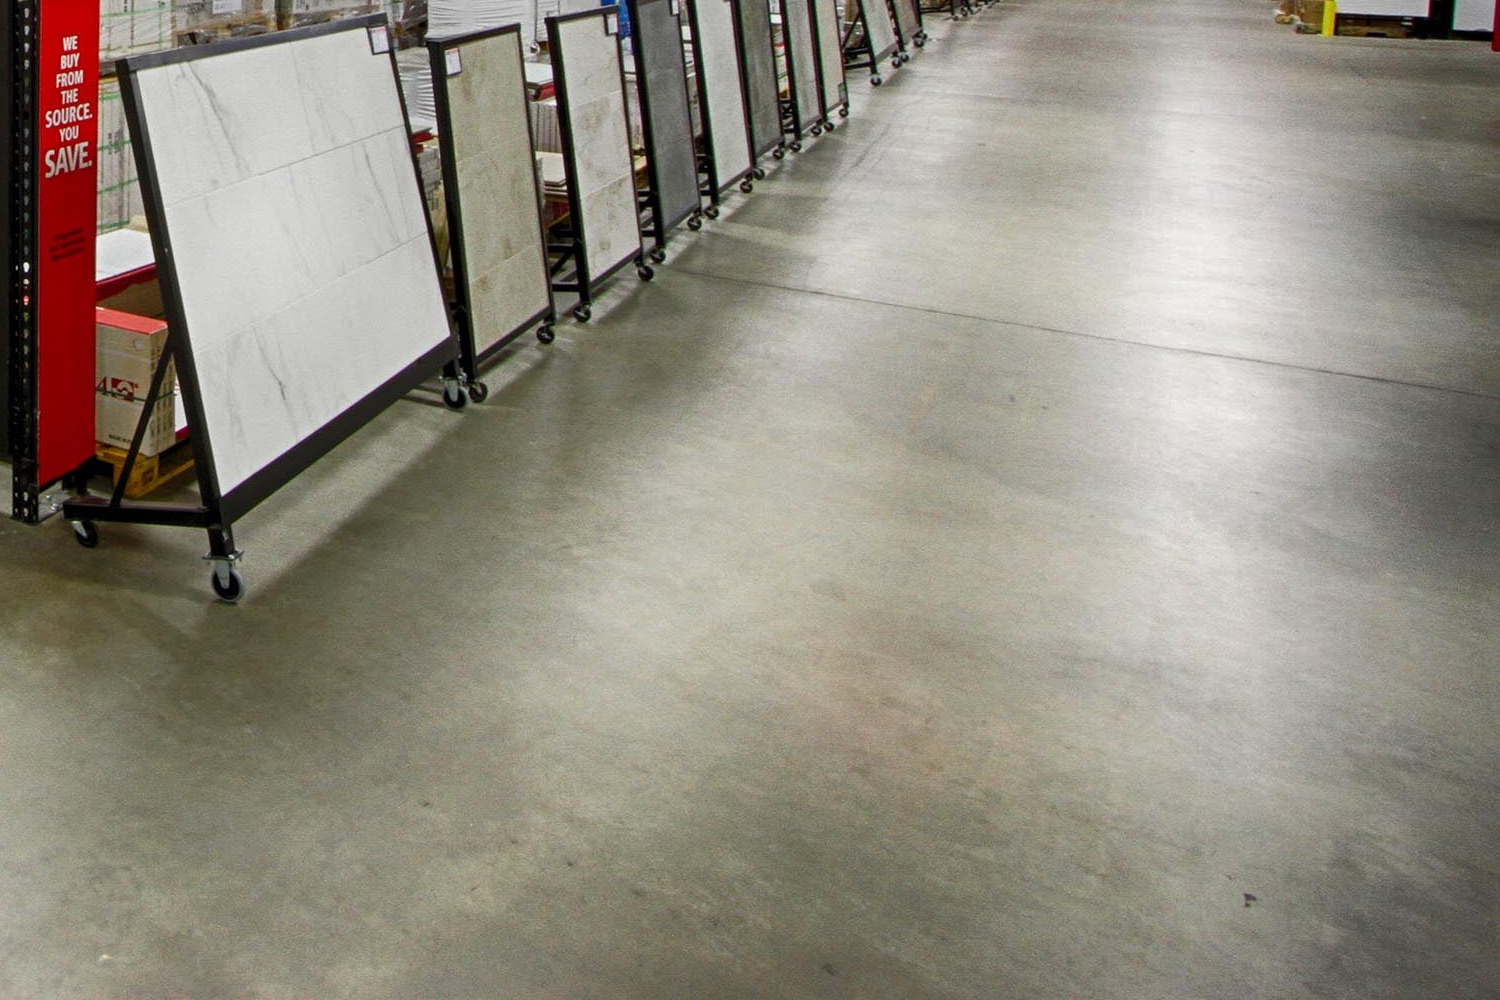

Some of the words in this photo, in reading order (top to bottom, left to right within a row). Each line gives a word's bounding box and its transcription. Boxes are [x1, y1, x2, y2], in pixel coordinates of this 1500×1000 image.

[62, 35, 78, 51] WE
[60, 53, 80, 69] BUY
[56, 70, 84, 88] FROM
[60, 88, 79, 105] THE
[45, 102, 93, 129] SOURCE.
[59, 125, 80, 142] YOU
[45, 141, 92, 178] SAVE.
